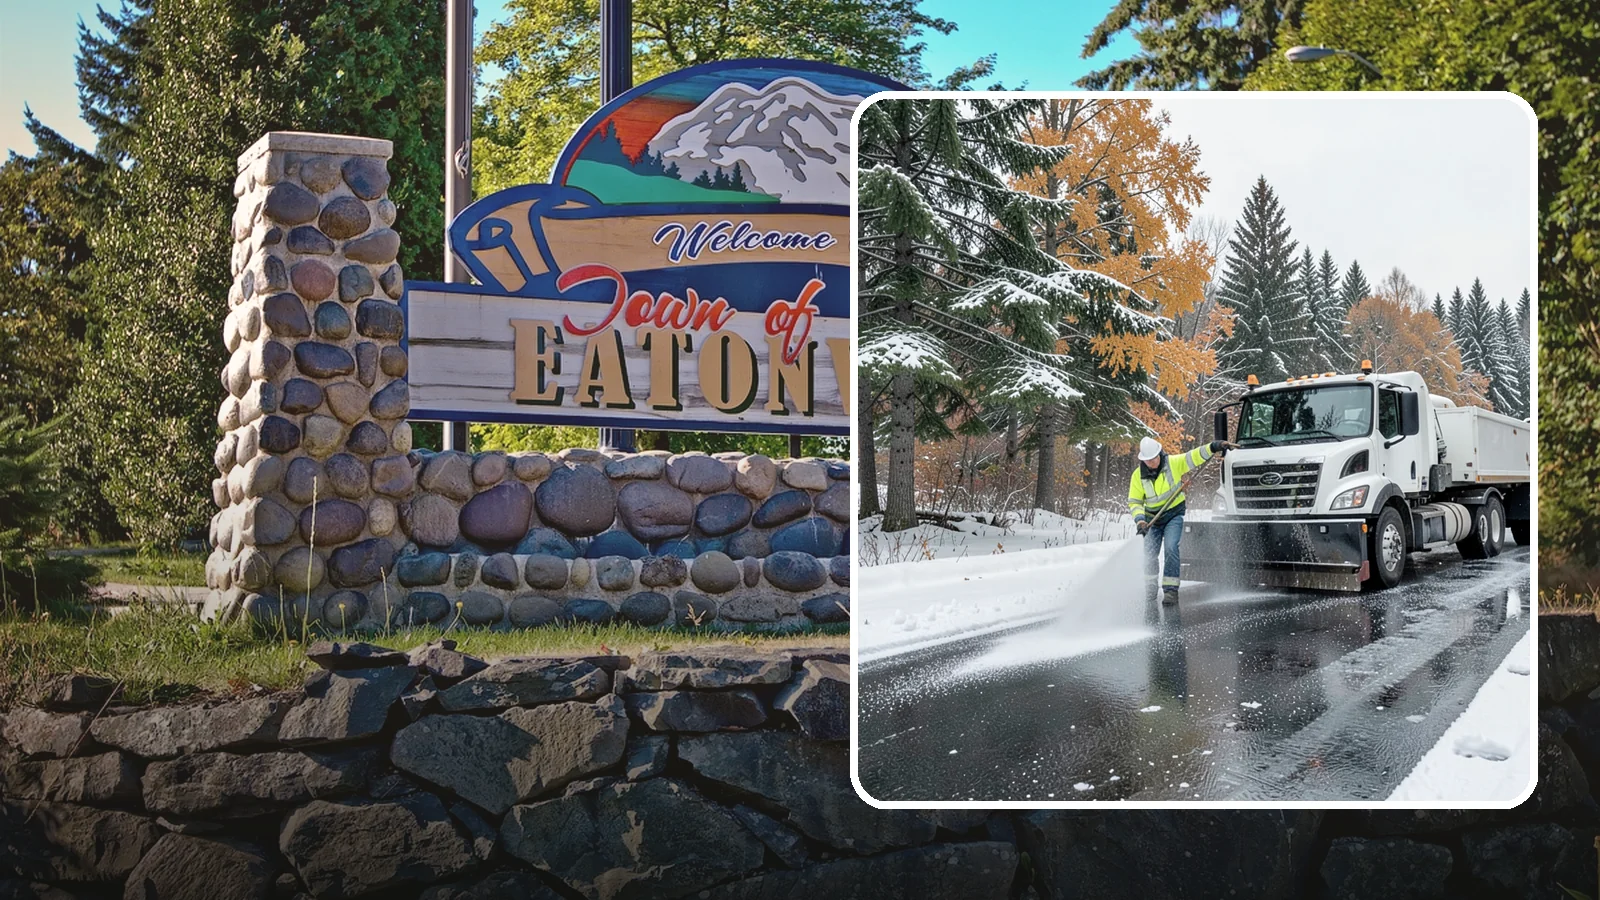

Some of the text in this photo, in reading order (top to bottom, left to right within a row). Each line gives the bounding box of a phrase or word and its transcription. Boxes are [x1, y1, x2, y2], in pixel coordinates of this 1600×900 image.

[653, 221, 837, 263] Welcome
[557, 264, 826, 365] Town of
